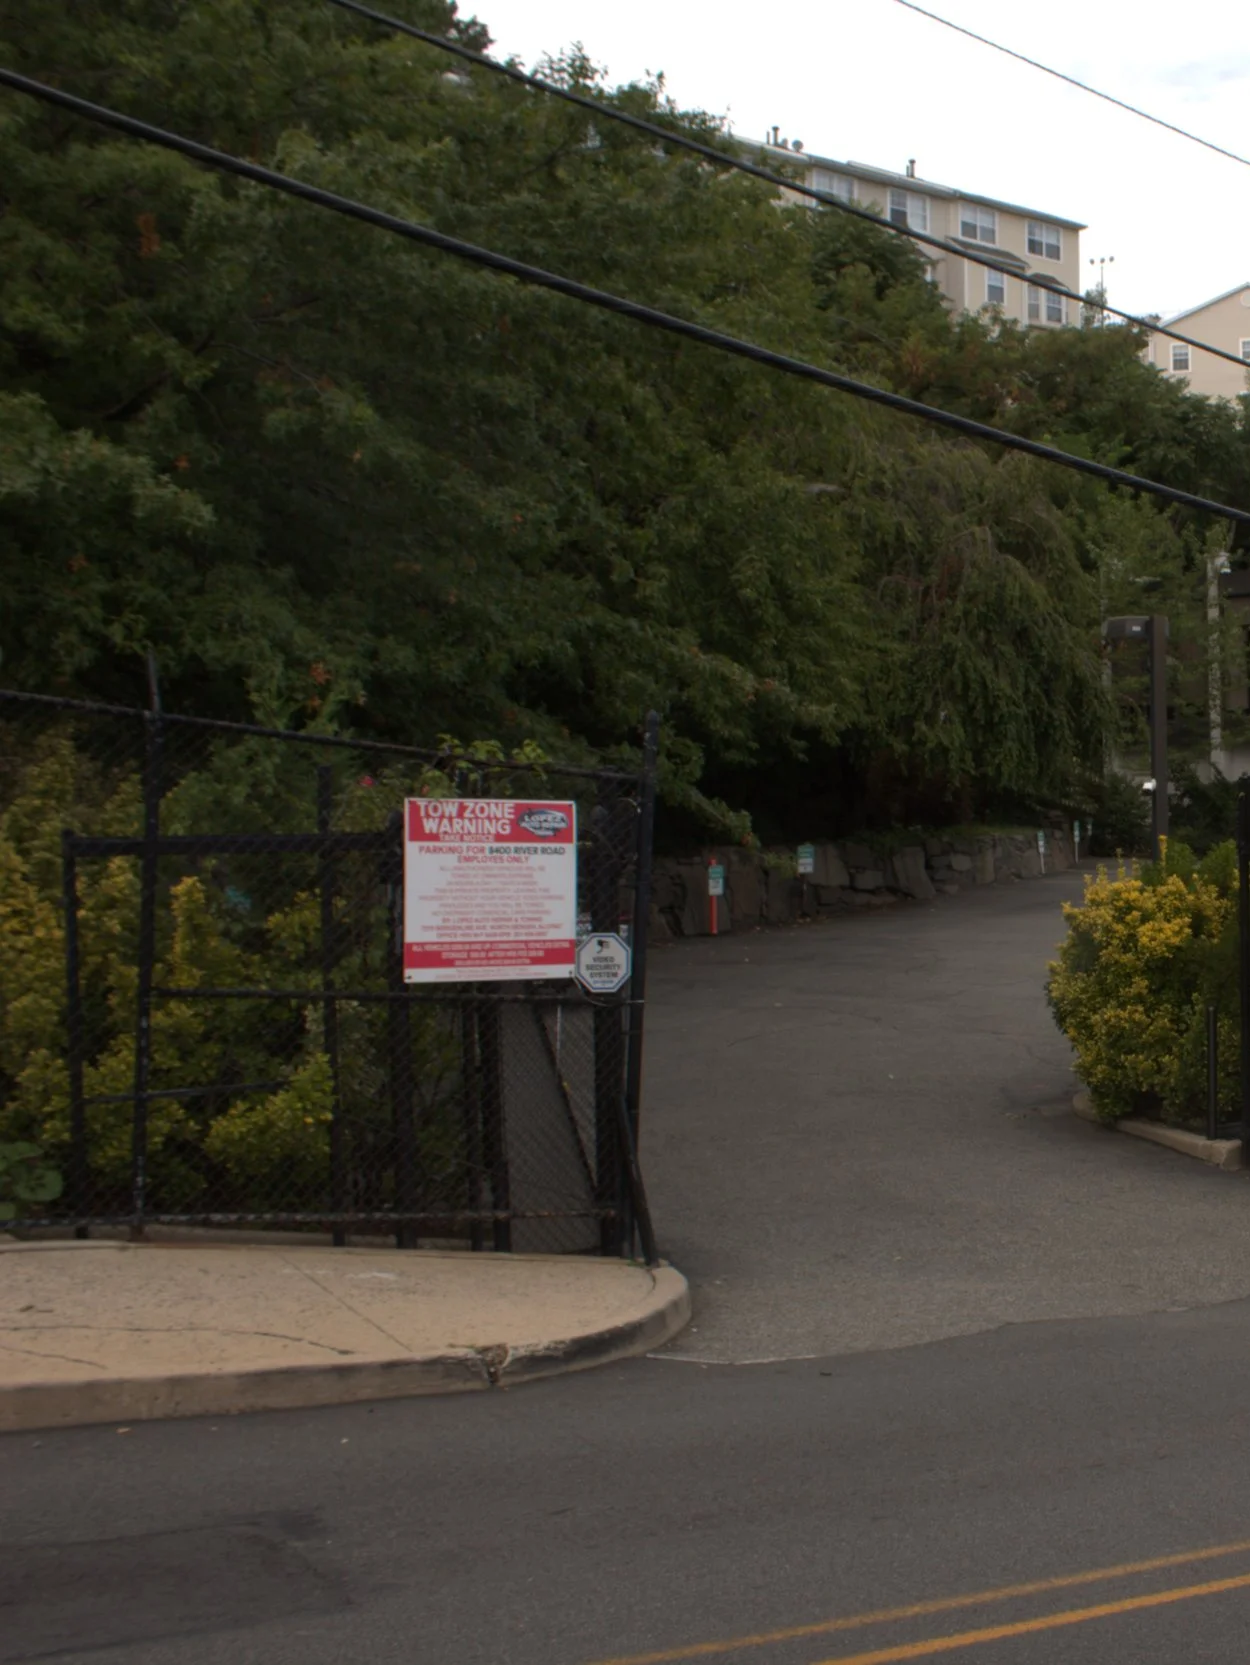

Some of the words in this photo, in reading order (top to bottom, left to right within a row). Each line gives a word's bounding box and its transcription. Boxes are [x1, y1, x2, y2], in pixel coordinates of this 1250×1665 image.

[417, 801, 459, 817] TOW
[463, 802, 515, 819] ZONE
[422, 818, 511, 835] WARNING
[419, 846, 463, 855] PARKING
[466, 846, 486, 855] FOR
[513, 847, 538, 855] RIVER
[540, 847, 566, 855] ROAD
[506, 855, 529, 864] ONLY
